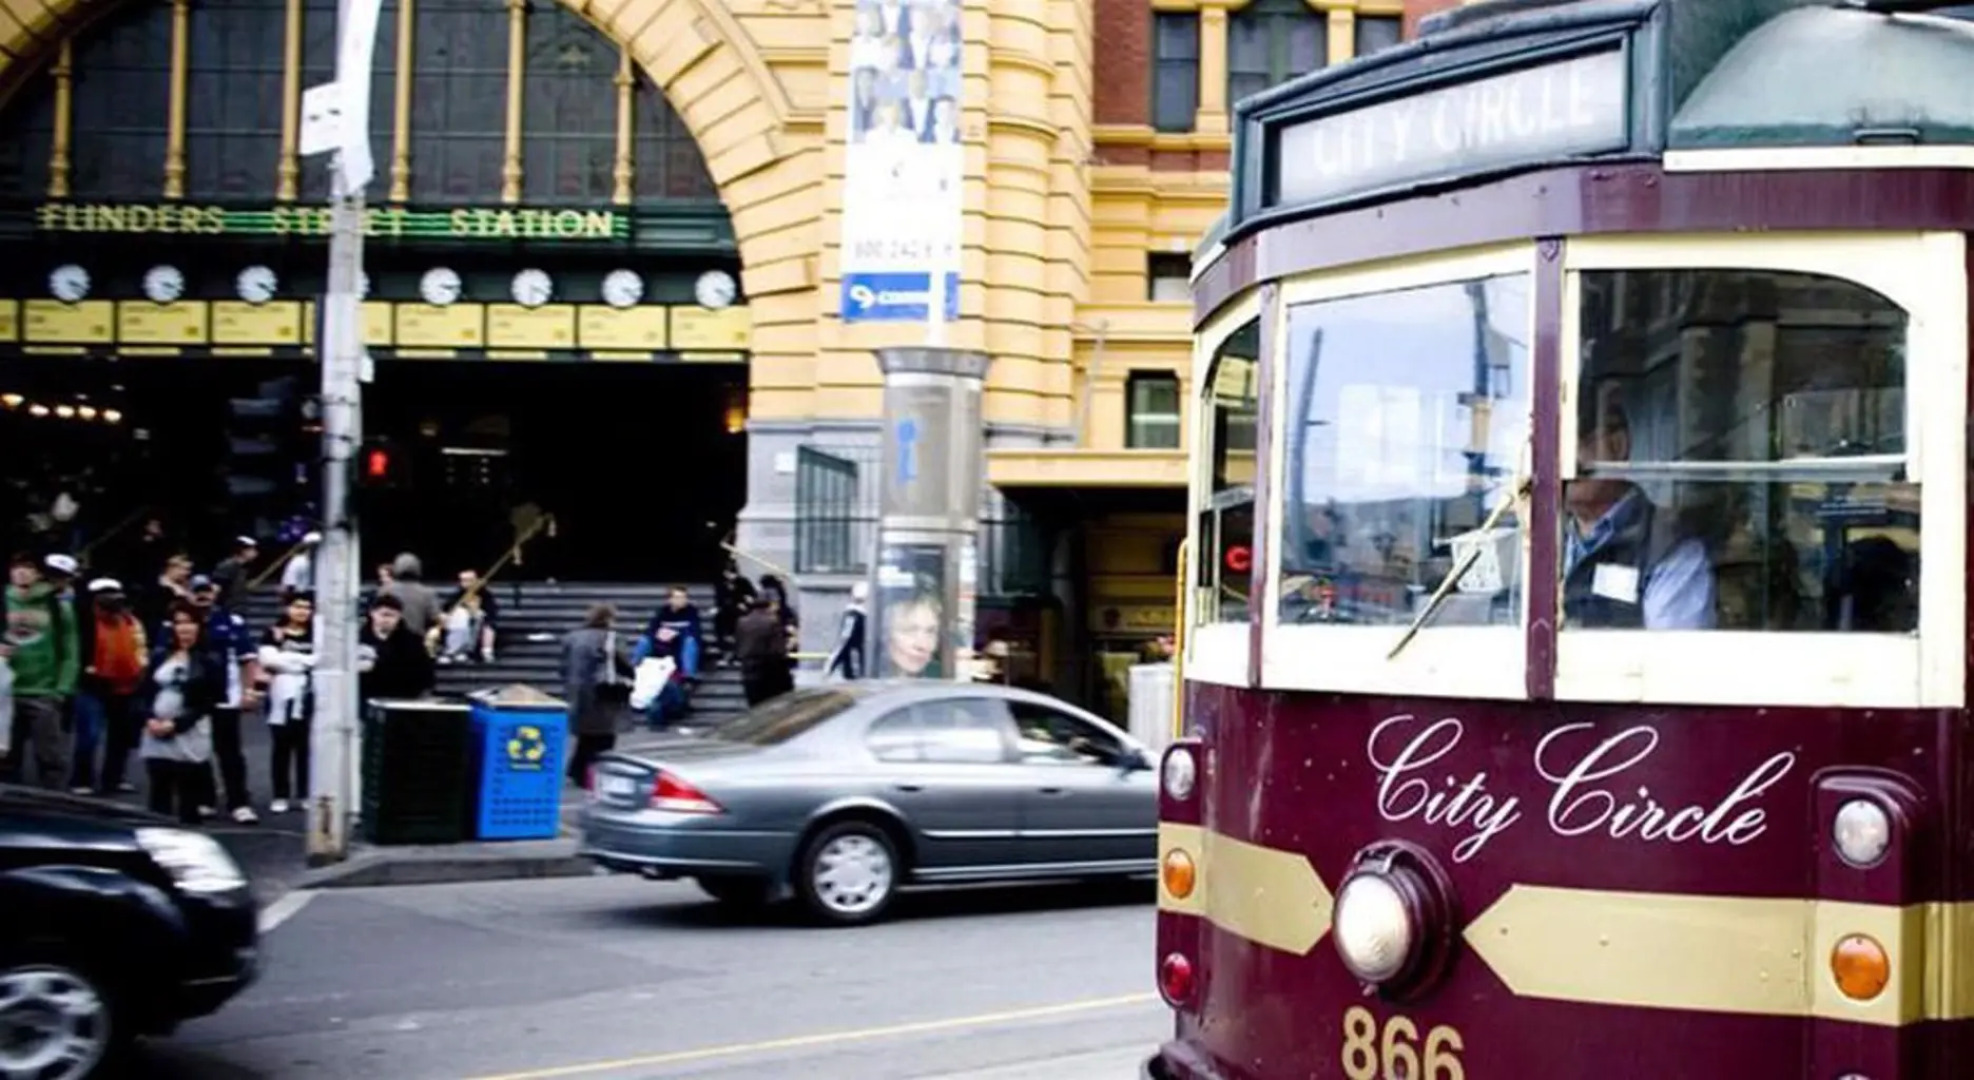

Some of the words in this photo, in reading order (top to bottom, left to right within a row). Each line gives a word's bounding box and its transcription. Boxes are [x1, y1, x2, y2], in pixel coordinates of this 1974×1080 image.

[1312, 112, 1416, 176] CITY
[1430, 64, 1594, 153] CIRCLE
[37, 204, 225, 233] FLINDERS
[451, 209, 614, 238] STATION
[1367, 714, 1522, 863] City
[1534, 722, 1796, 846] Circle
[1341, 1005, 1466, 1080] 866
